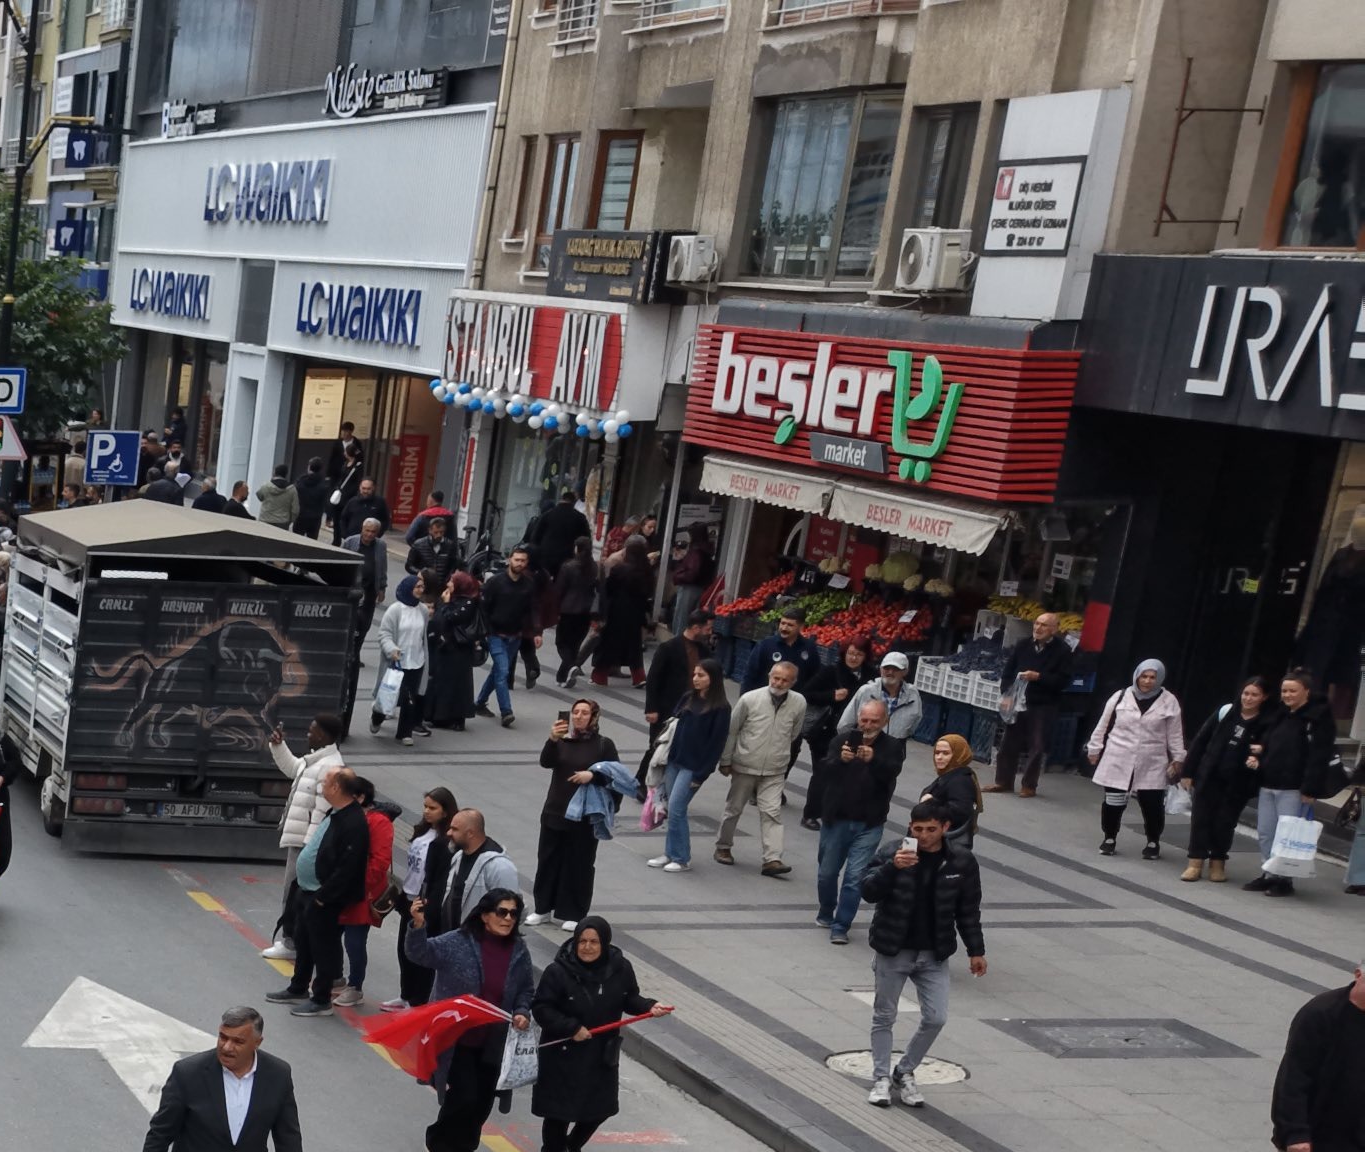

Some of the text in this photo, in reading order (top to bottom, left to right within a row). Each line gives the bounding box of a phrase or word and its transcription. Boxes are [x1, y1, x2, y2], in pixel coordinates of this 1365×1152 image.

[549, 311, 607, 410] AVM
[90, 433, 116, 469] P
[824, 441, 867, 467] market
[394, 446, 420, 515] İNDİRİM
[765, 482, 800, 501] MARKET
[907, 513, 953, 537] MARKET
[164, 804, 176, 815] 50
